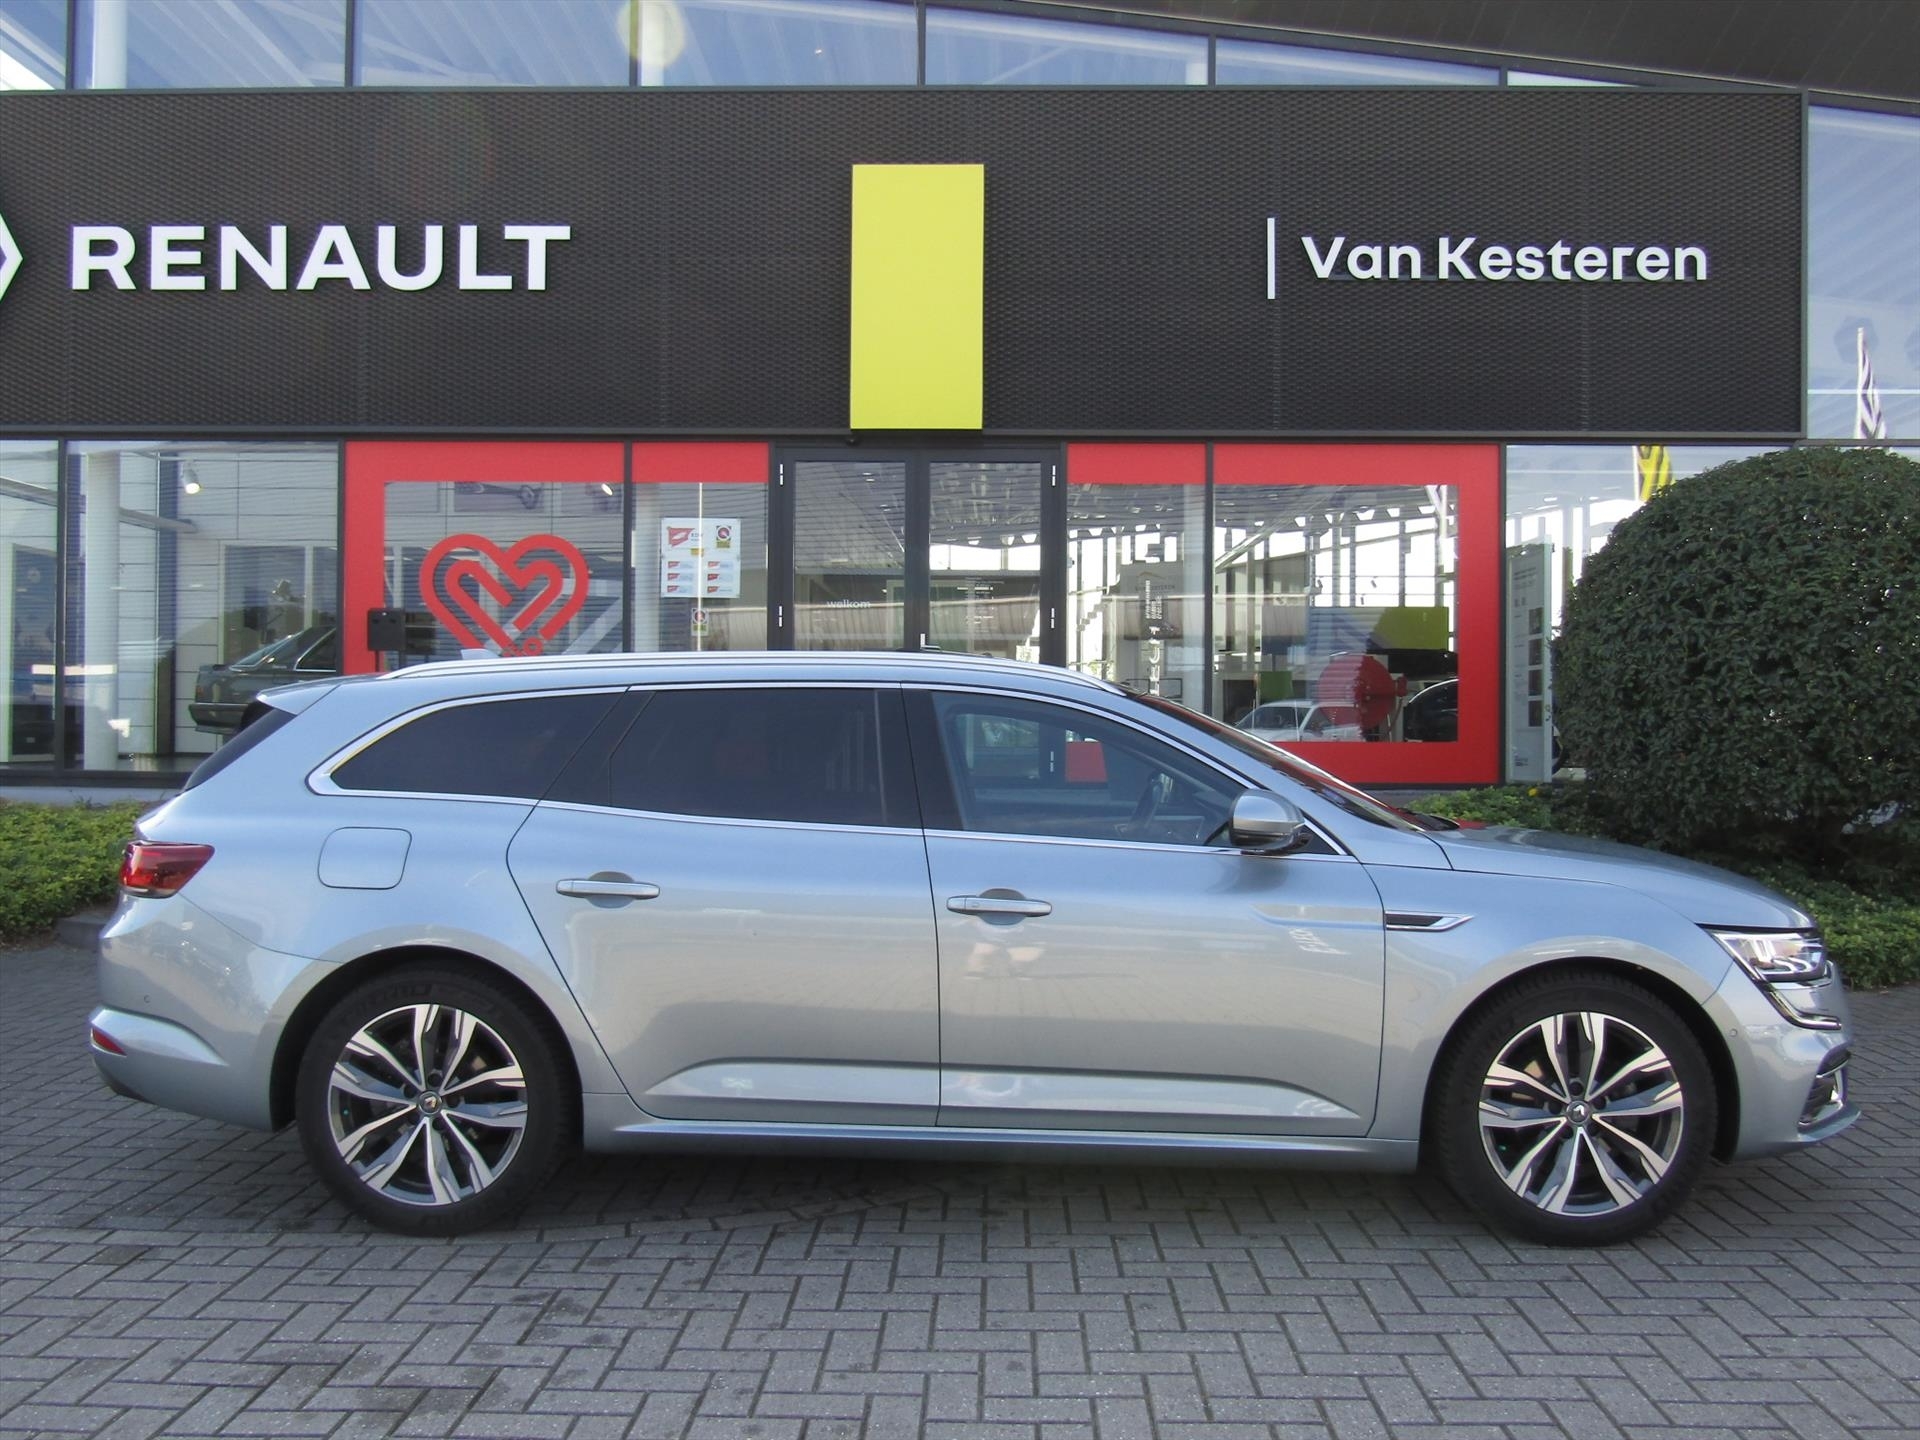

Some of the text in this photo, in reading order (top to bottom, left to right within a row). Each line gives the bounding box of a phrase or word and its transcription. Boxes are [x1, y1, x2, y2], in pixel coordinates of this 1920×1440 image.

[72, 225, 572, 291] RENAULT
[1301, 236, 1707, 281] Van Kesteren
[826, 599, 872, 608] welkom
